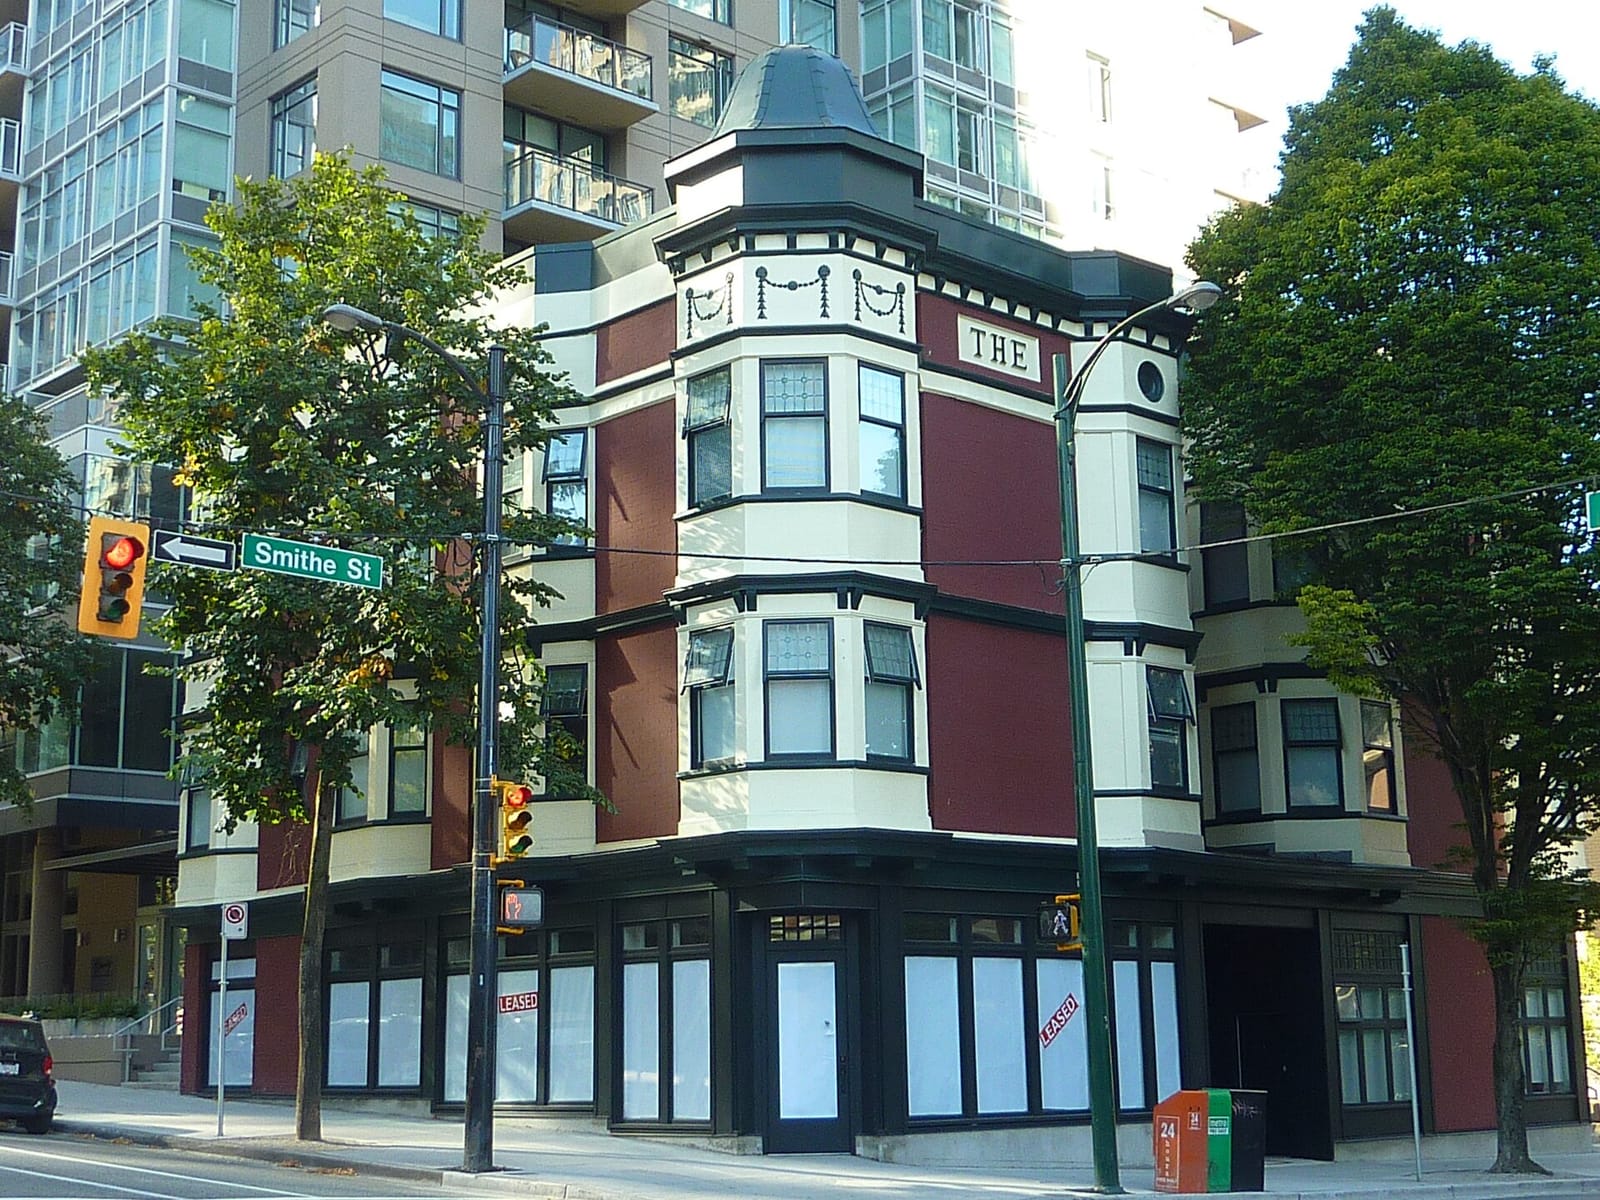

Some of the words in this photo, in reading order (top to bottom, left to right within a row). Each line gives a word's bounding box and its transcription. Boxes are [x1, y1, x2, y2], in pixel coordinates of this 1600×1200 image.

[969, 326, 1028, 371] THE
[254, 541, 337, 575] Smithe
[347, 557, 372, 582] St
[500, 993, 538, 1012] LEASED
[1040, 997, 1076, 1047] LEASED
[1160, 1121, 1176, 1138] 24
